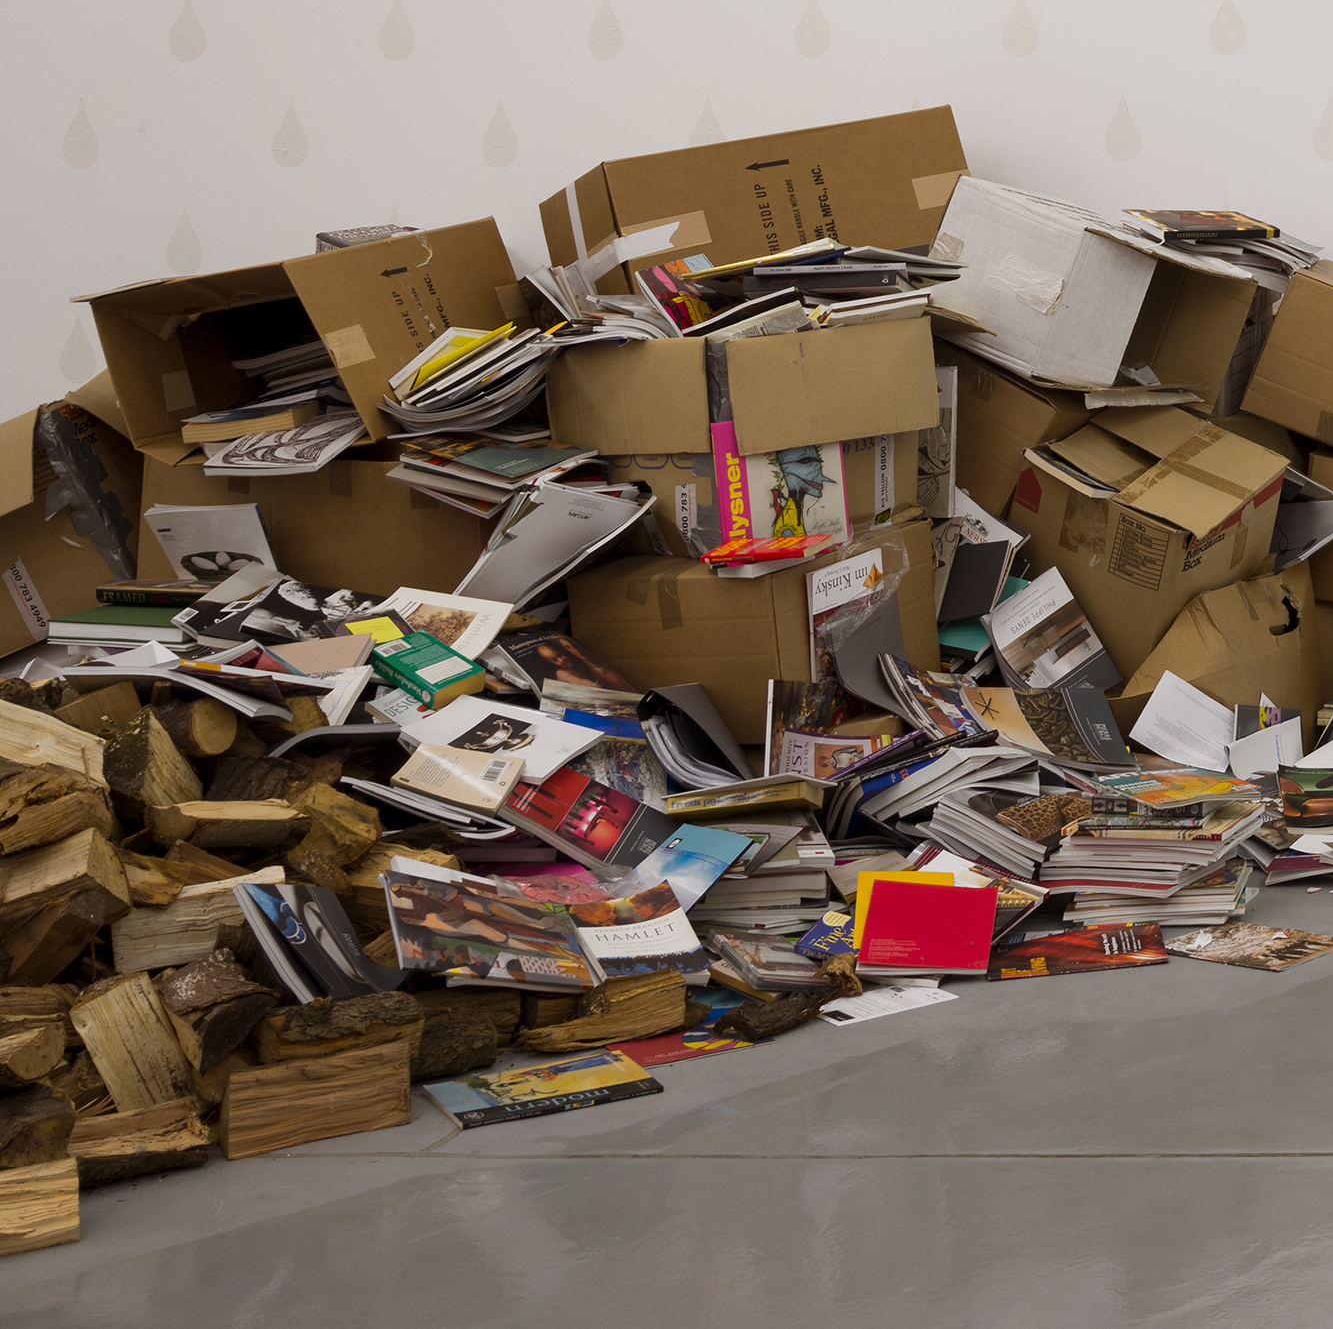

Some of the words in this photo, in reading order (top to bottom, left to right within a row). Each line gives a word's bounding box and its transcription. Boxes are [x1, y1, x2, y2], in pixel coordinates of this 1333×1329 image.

[785, 178, 795, 193] CARE
[811, 164, 825, 186] INC.
[754, 183, 767, 198] UP
[788, 193, 798, 208] WITH
[758, 202, 775, 228] SIDE
[792, 208, 803, 230] HANDLE
[766, 233, 780, 255] HIS
[797, 229, 807, 246] AGILE
[424, 273, 437, 296] INC.
[392, 291, 404, 306] UP
[401, 310, 418, 337] SIDE
[681, 492, 689, 512] 783
[727, 452, 750, 540] lysner
[682, 515, 690, 541] 0800
[1121, 515, 1135, 527] Box
[1181, 555, 1203, 572] Box
[101, 588, 147, 603] FRAMED
[814, 572, 852, 597] Kinsky
[19, 580, 34, 603] 783
[29, 603, 46, 628] 4949
[1030, 598, 1057, 620] PHILIPPE
[1010, 616, 1032, 635] DENYS
[383, 696, 419, 718] DESIG
[594, 921, 675, 941] HAMLET
[813, 927, 846, 952] Fine
[505, 1088, 613, 1113] modern
